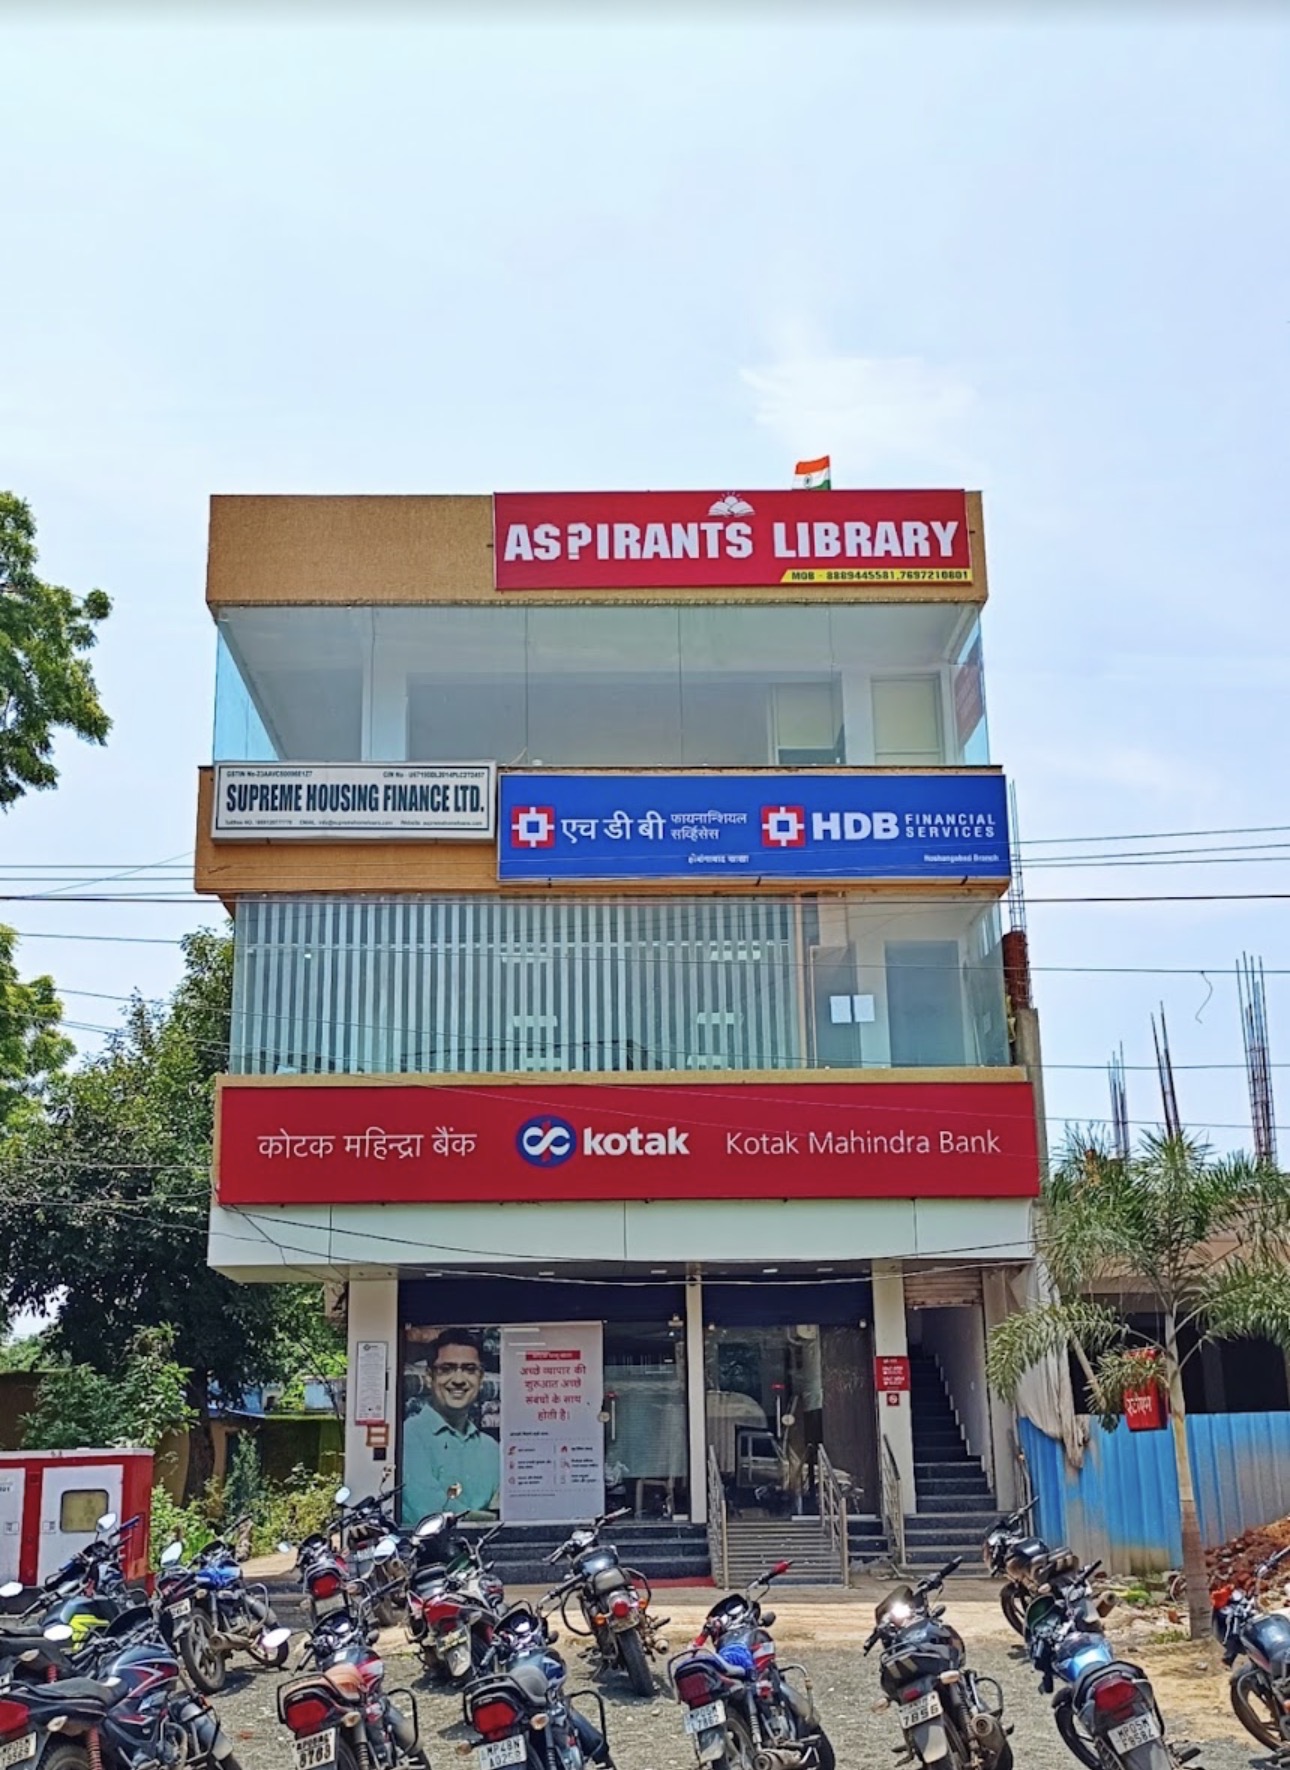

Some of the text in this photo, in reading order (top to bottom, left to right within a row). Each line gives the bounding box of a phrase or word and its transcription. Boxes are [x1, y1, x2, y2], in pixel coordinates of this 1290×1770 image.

[503, 520, 959, 561] ASPIRANTS LIBRARY
[791, 571, 815, 580] MOB
[226, 783, 485, 812] SUPREME HOUSING FINANCE LTD.
[561, 811, 666, 844] एच डी बी
[811, 811, 900, 840] HDB
[905, 813, 996, 826] FINANCIAL
[905, 826, 995, 838] SERVICES
[257, 1125, 478, 1160] कोटक महिन्द्रा बैंक
[583, 1126, 690, 1156] kotak
[726, 1129, 1002, 1155] Kotak Mahindra Bank
[574, 1363, 586, 1375] की
[552, 1393, 561, 1404] के
